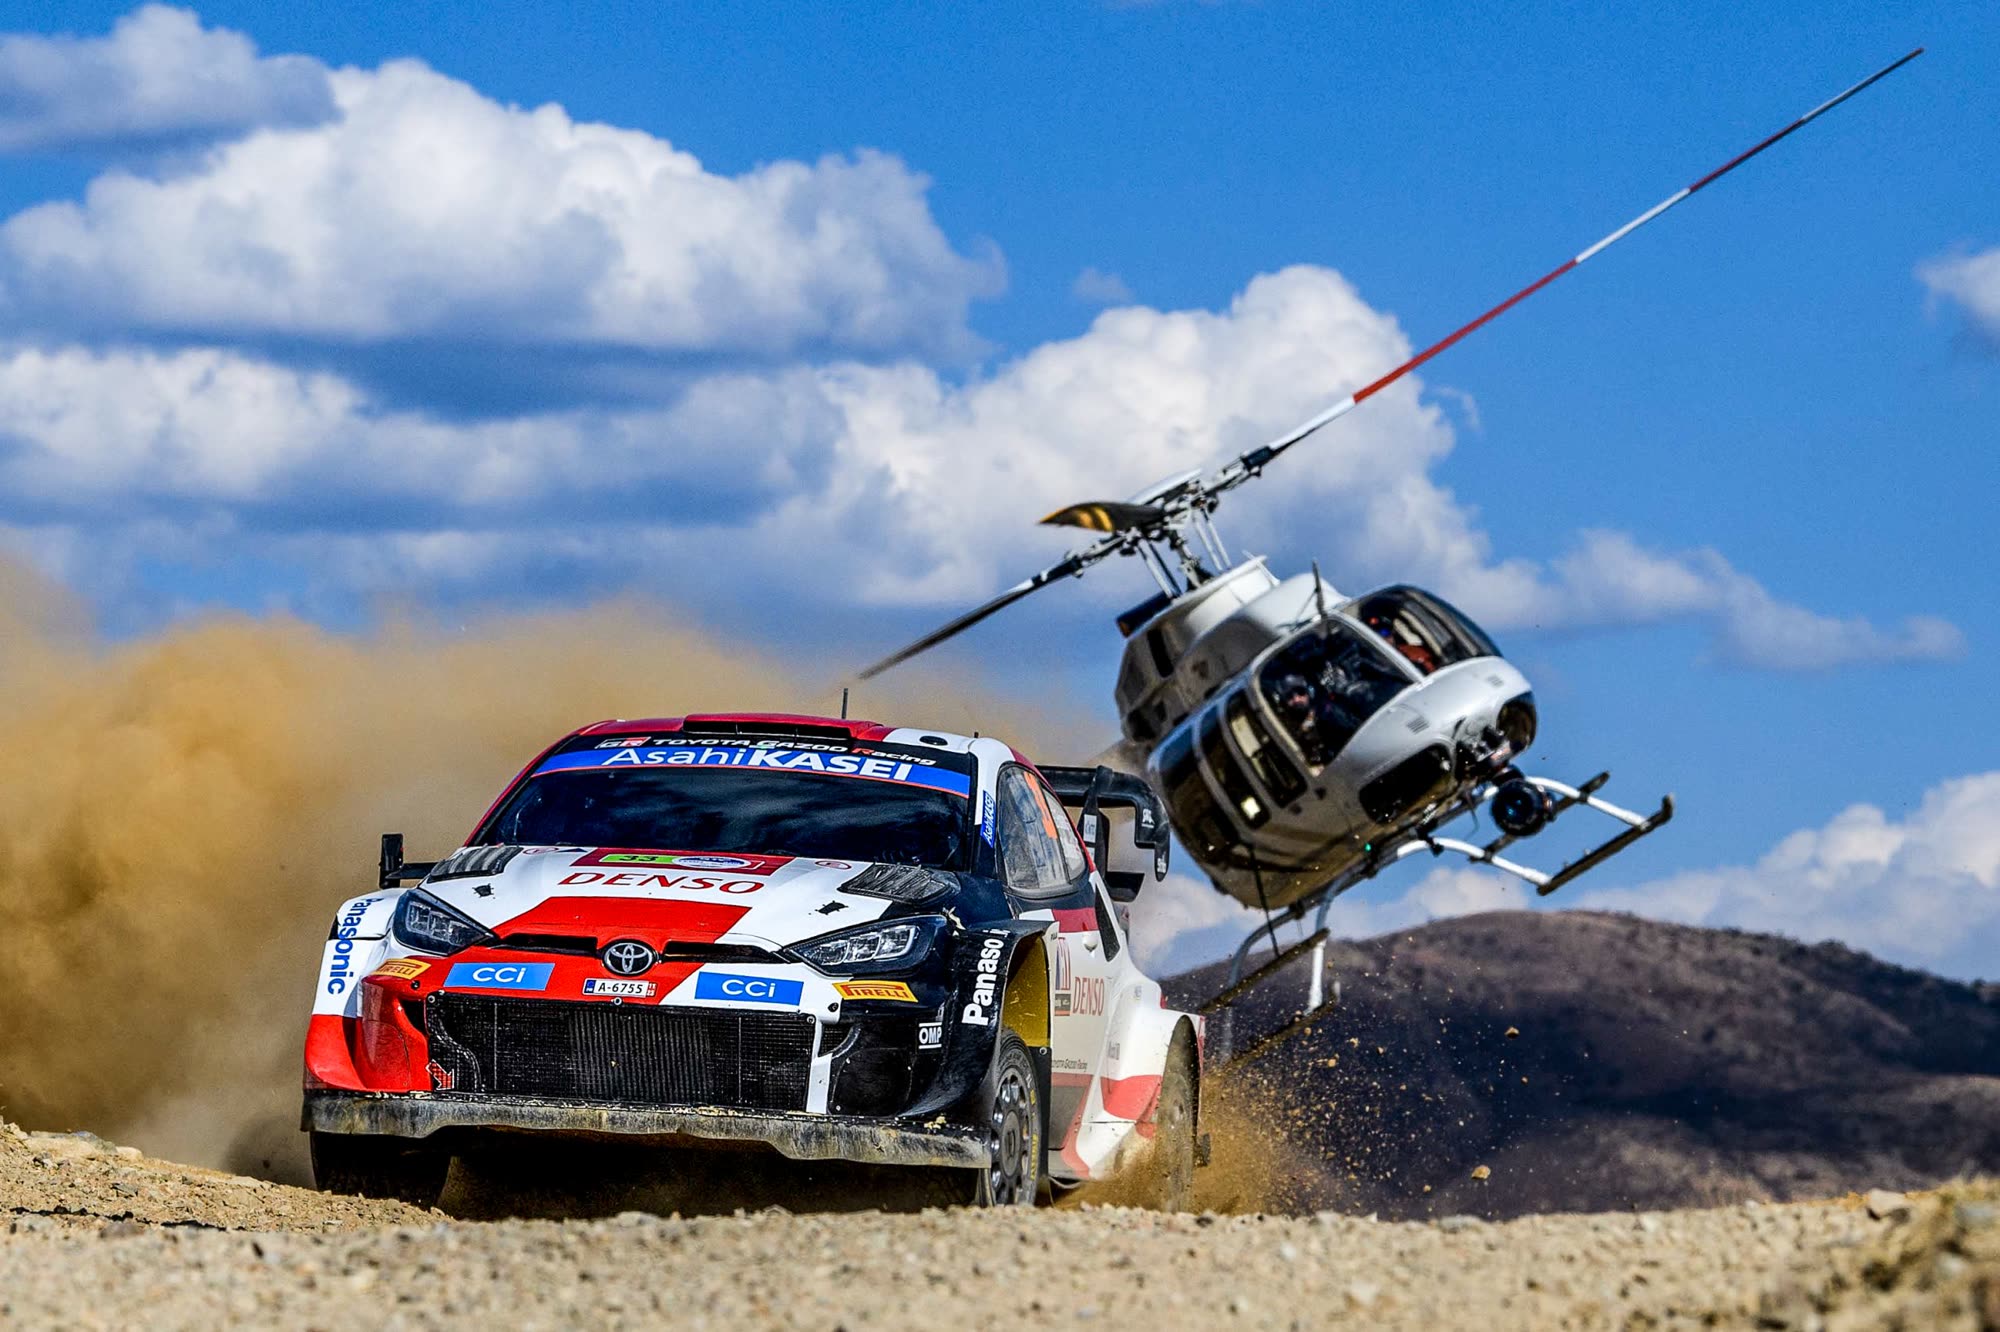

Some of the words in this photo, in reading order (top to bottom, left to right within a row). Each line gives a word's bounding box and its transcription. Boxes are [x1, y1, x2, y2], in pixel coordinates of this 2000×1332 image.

[749, 740, 848, 751] GAZOO
[852, 748, 937, 765] Racing
[558, 872, 764, 893] DENSO
[597, 982, 643, 994] A-6755
[841, 983, 909, 998] PIRELLI
[1072, 976, 1105, 1016] DENSO
[918, 1027, 942, 1044] OMP
